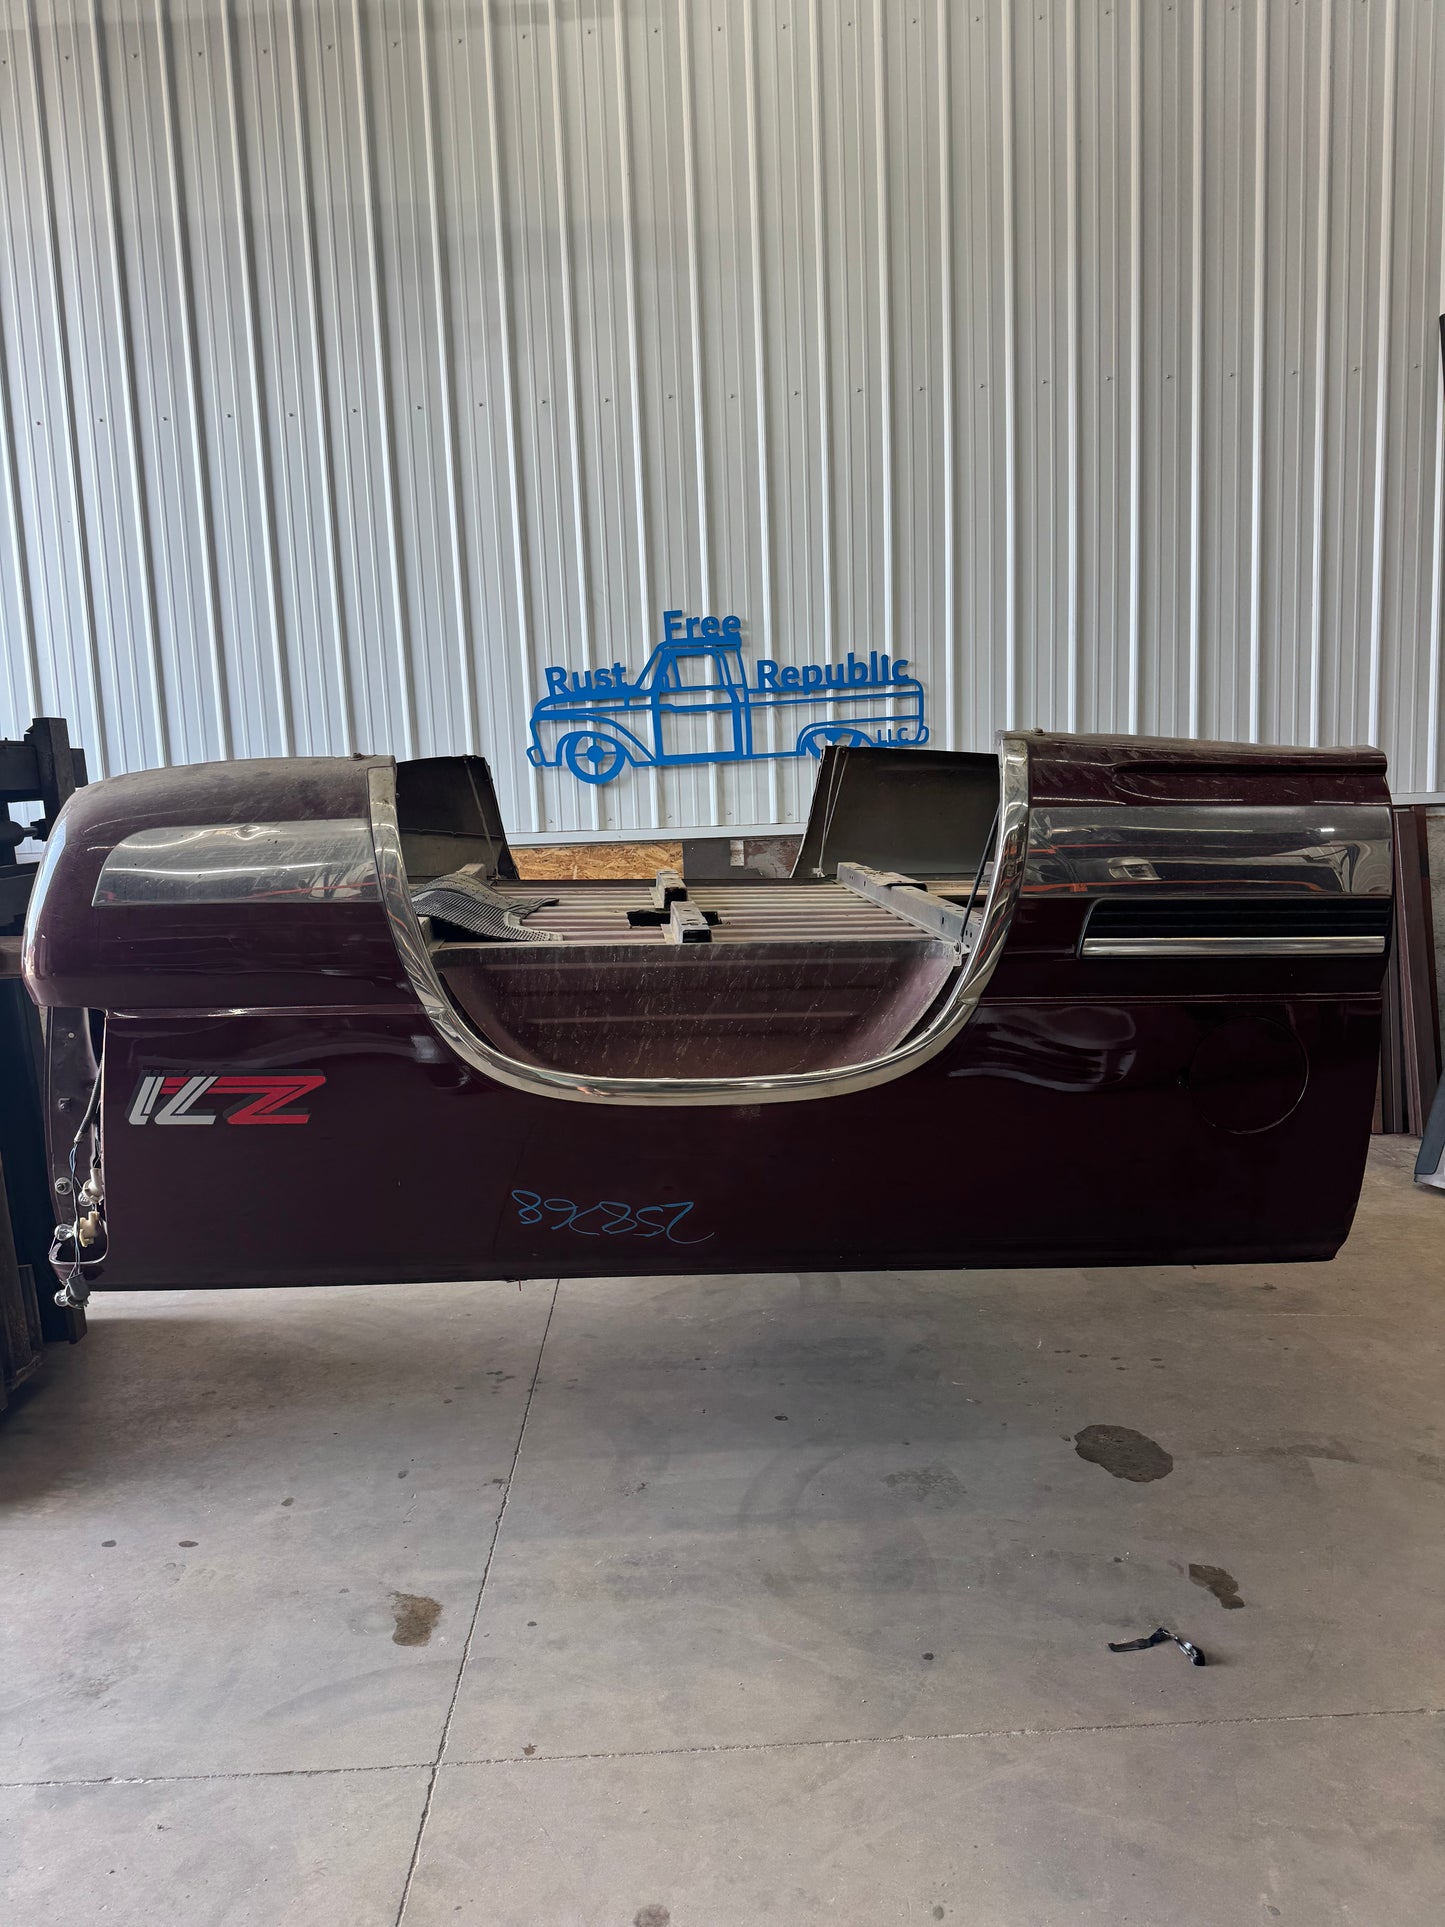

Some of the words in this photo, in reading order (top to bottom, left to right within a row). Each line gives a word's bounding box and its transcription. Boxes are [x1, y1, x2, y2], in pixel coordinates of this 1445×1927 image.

[663, 609, 741, 642] Free
[545, 662, 627, 697] Rust
[757, 650, 911, 695] Republic
[877, 727, 909, 744] LLC
[127, 1074, 326, 1126] Z71
